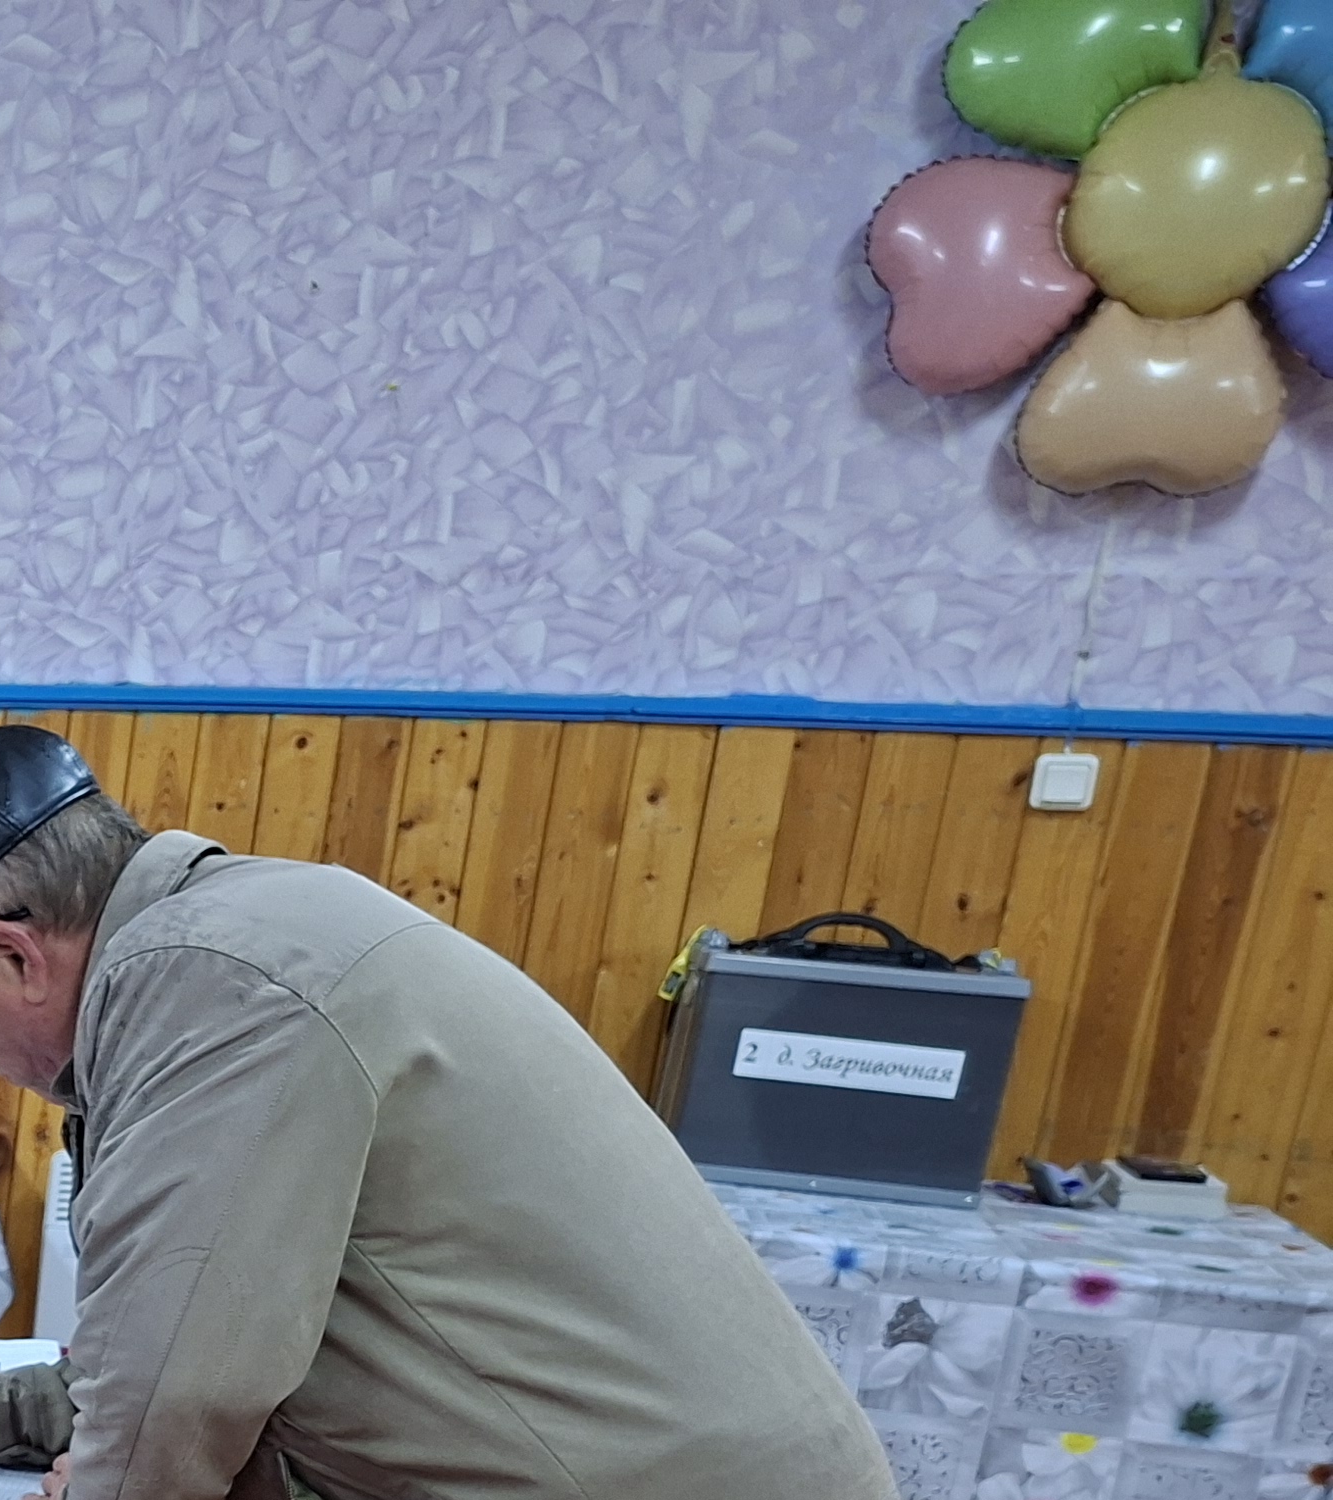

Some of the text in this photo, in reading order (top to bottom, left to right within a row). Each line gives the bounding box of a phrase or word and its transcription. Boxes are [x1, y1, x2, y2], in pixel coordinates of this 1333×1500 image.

[741, 1041, 955, 1085] 2 д. Загривочная
